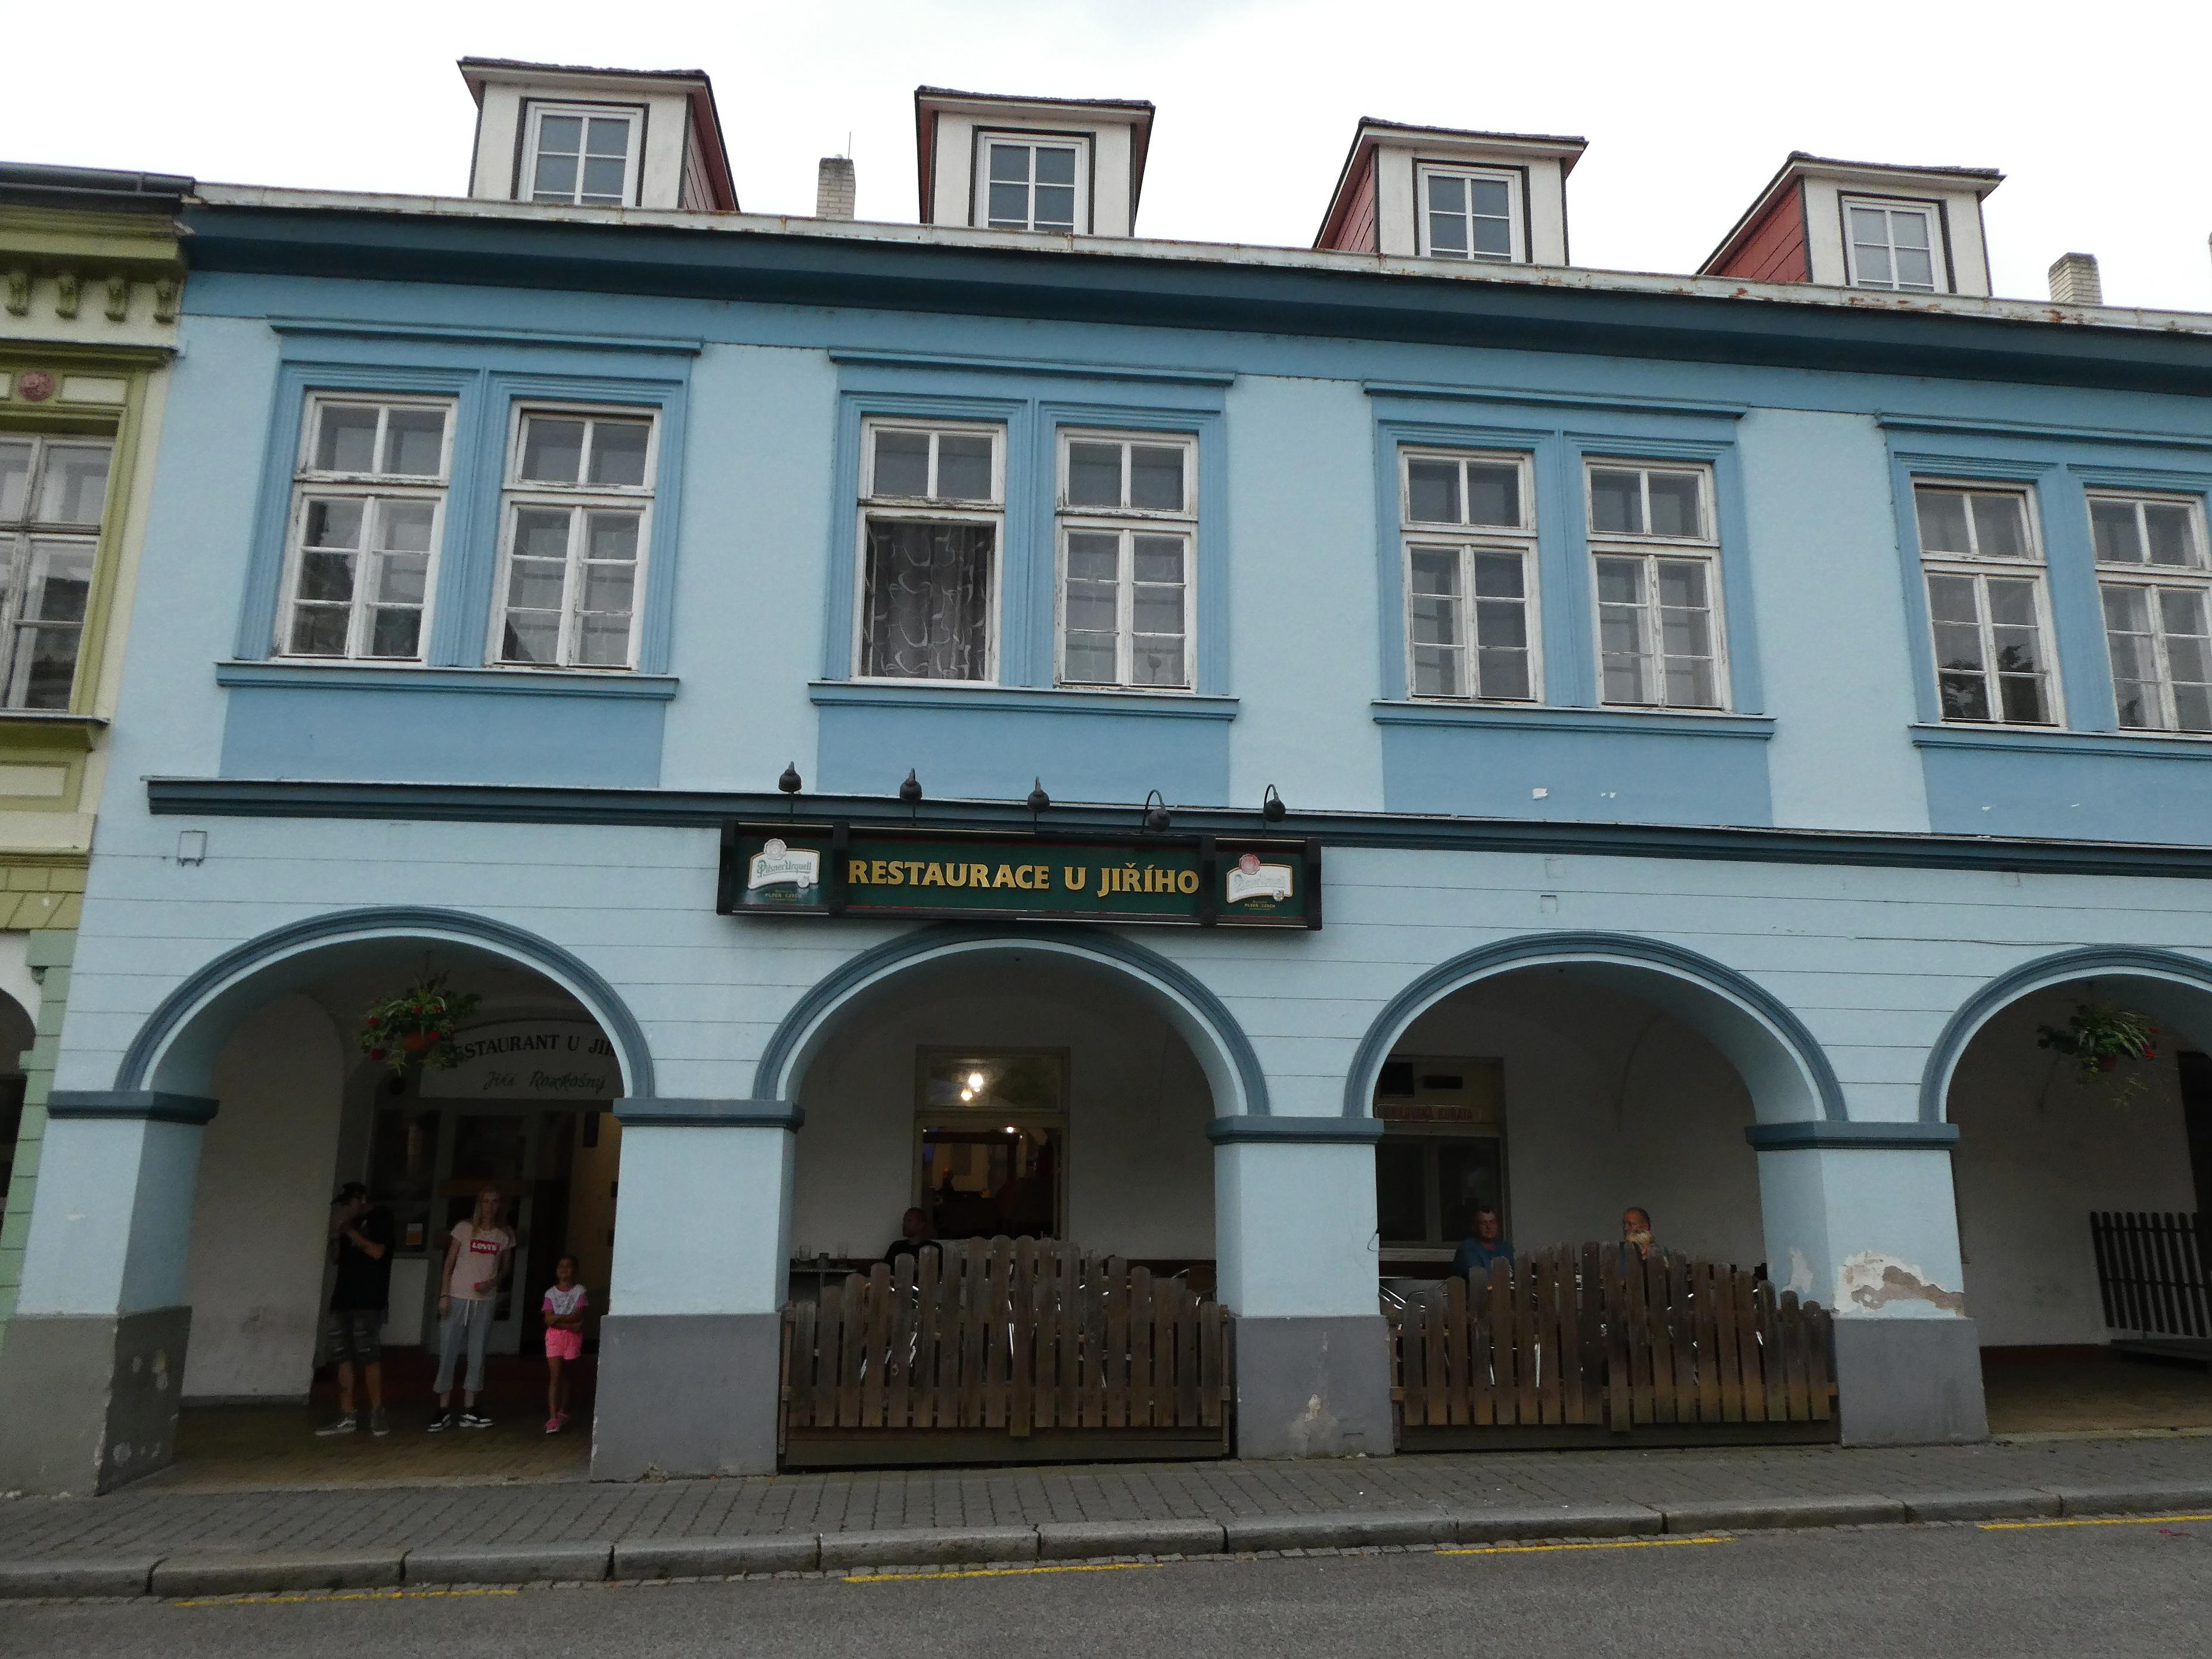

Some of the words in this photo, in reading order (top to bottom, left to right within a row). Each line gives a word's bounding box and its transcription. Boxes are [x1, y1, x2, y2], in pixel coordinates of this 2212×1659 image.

[757, 859, 785, 878] Pilsner
[785, 860, 812, 873] Urquell
[849, 860, 1050, 889] RESTAURACE
[1064, 866, 1086, 890] U
[1097, 862, 1199, 897] JIŘÍHO
[568, 1035, 580, 1051] U
